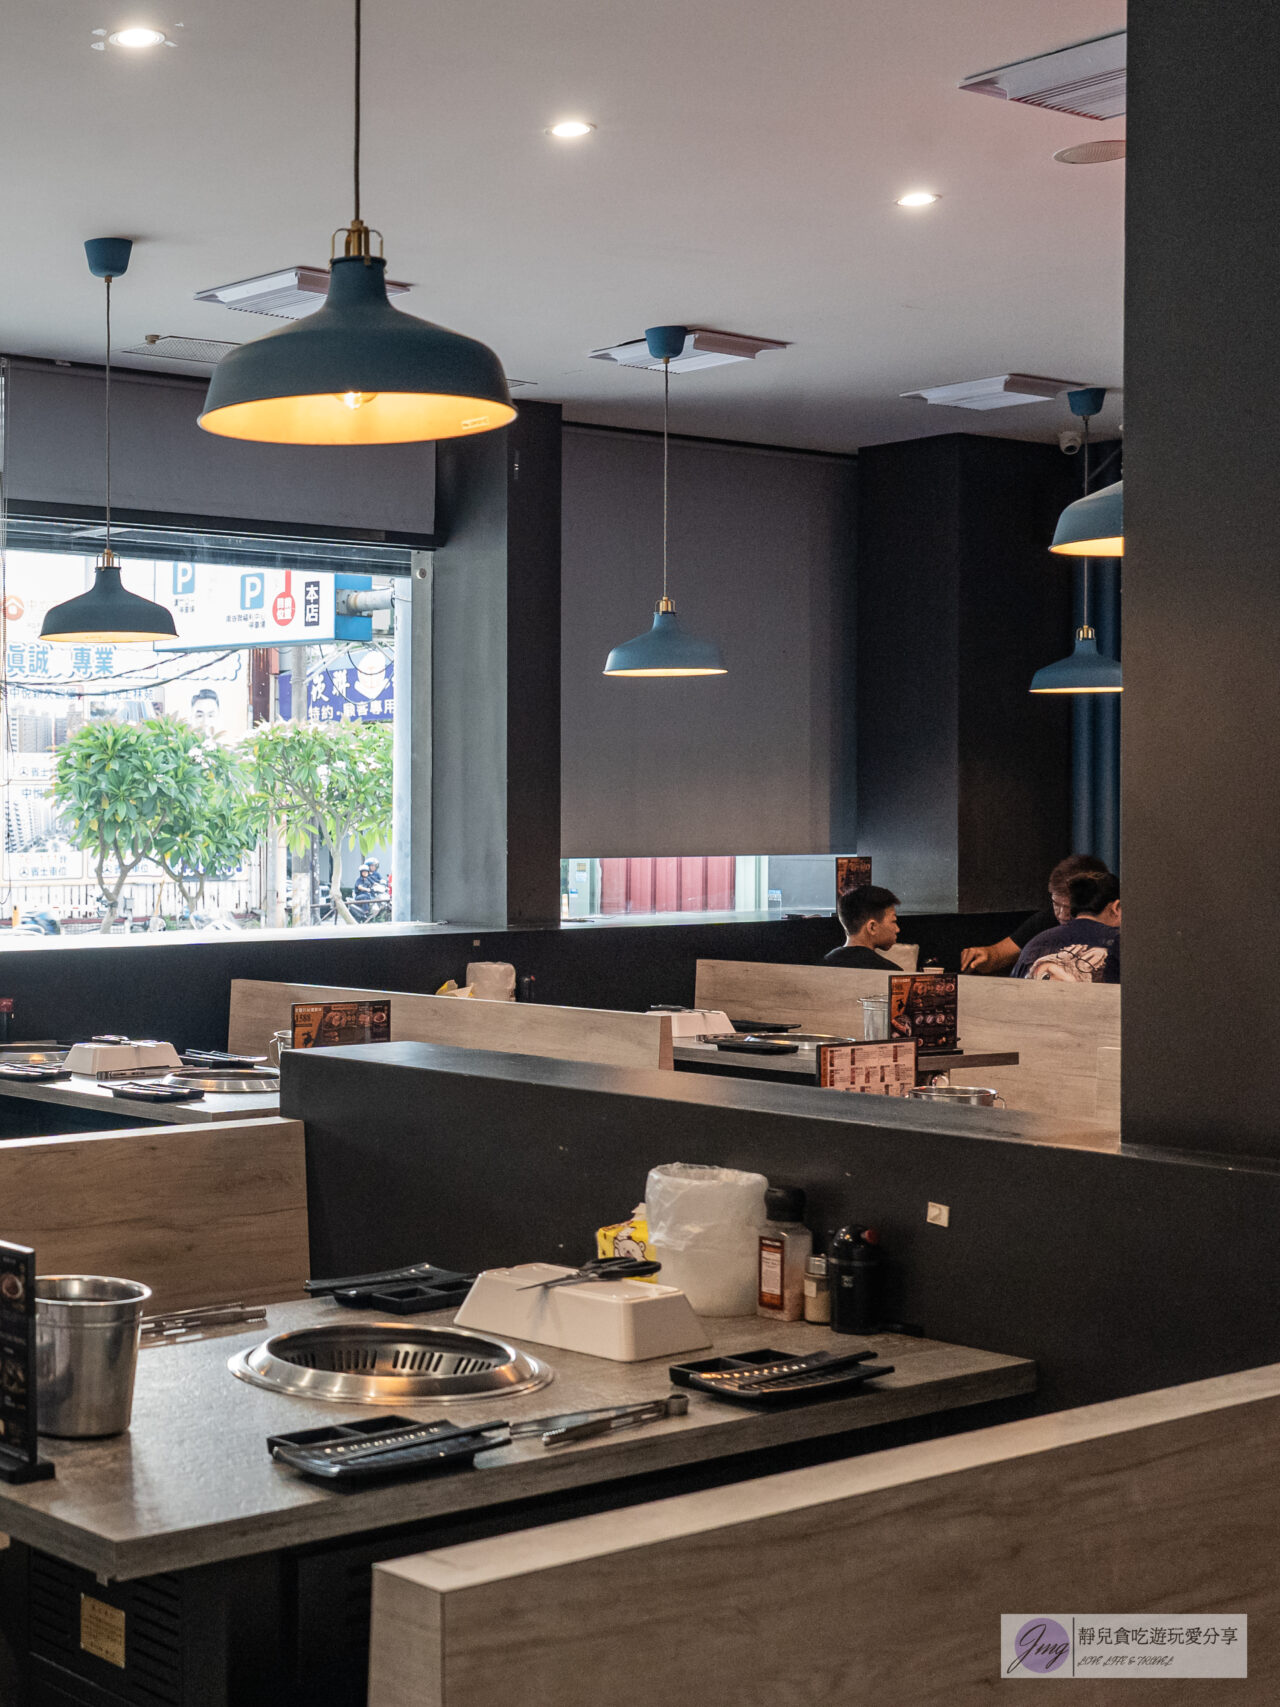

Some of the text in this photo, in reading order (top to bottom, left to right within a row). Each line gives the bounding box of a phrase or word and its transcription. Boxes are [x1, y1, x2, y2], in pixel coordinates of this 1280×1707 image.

[245, 576, 262, 609] P
[305, 583, 319, 623] 本店
[72, 646, 115, 676] 專業
